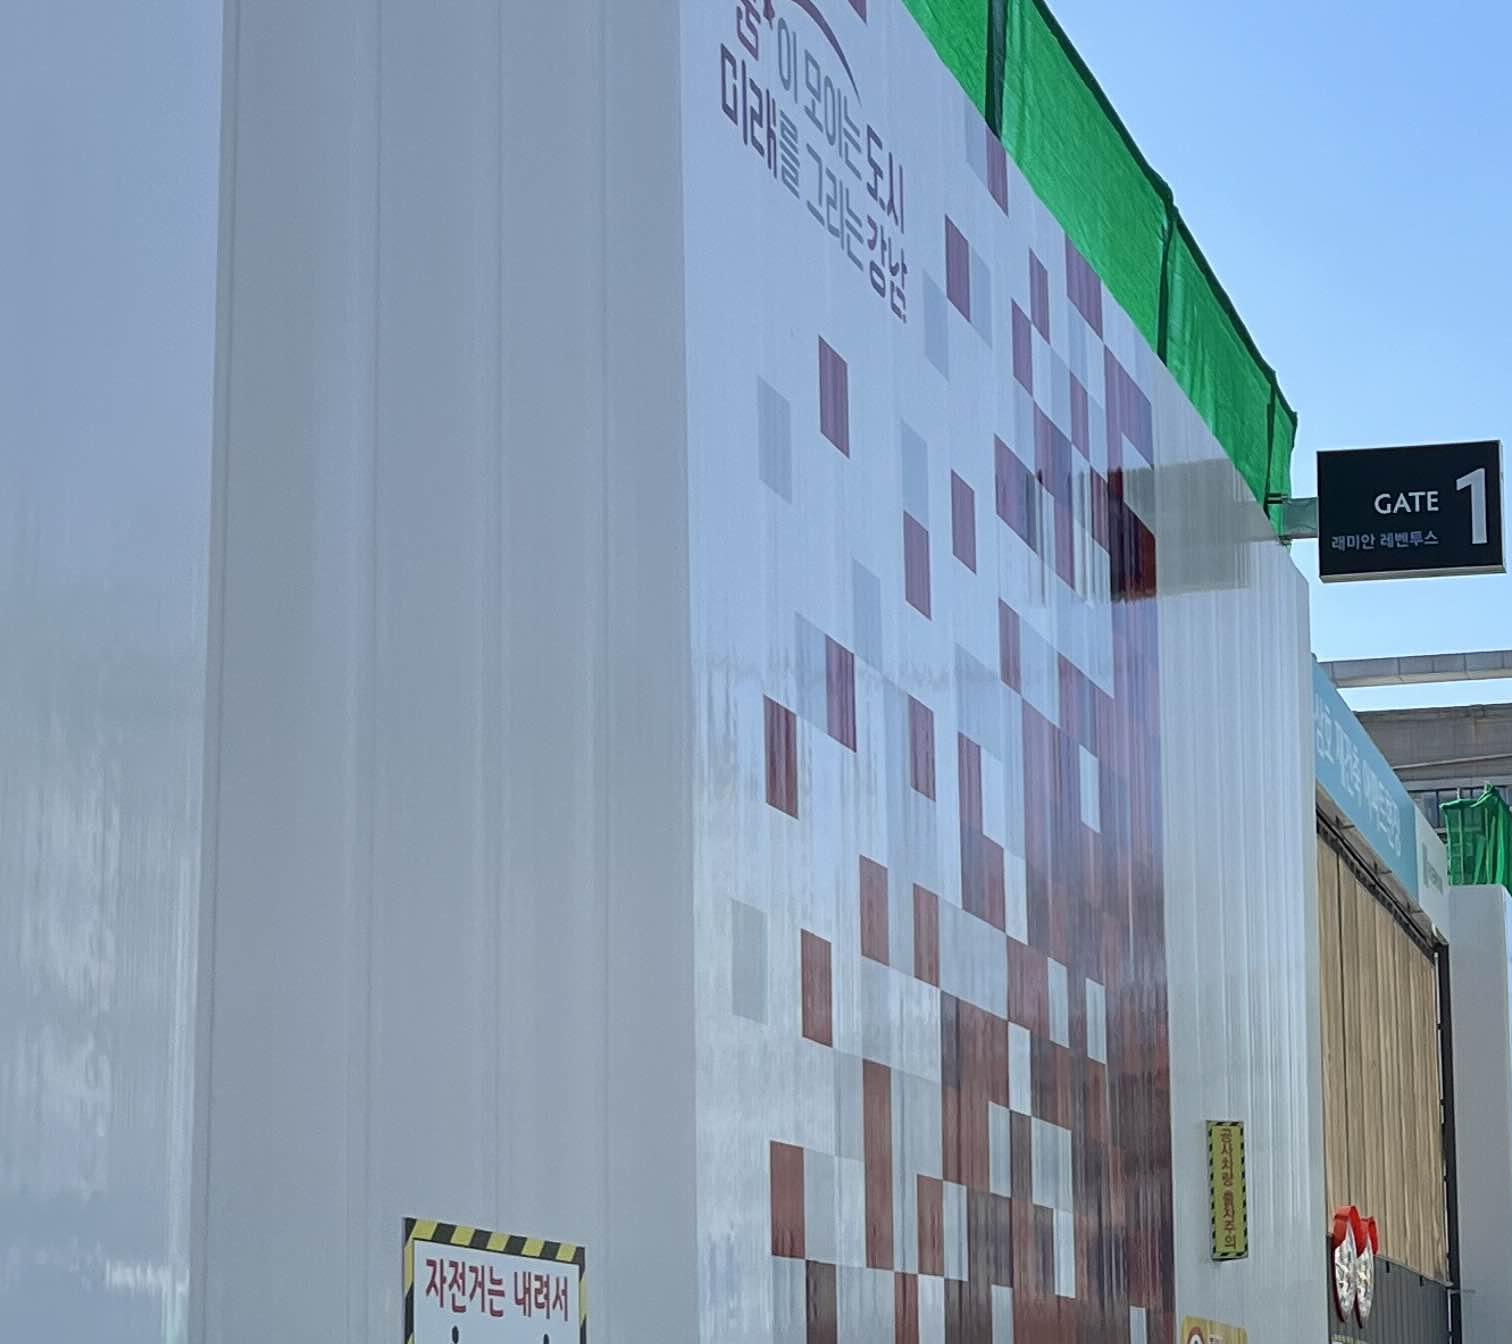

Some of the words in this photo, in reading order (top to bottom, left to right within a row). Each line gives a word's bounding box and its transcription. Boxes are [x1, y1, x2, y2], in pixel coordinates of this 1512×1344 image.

[804, 48, 863, 181] 모이는
[866, 123, 905, 234] 도시
[721, 42, 801, 200] 미래를
[805, 142, 864, 271] 그리는
[867, 213, 908, 324] 강남
[1331, 532, 1376, 552] 래미안
[1379, 530, 1439, 549] 레벤투스
[1374, 490, 1439, 515] GATE
[1455, 467, 1488, 545] 1
[425, 1257, 506, 1318] 자전거는
[513, 1270, 569, 1323] 내려서
